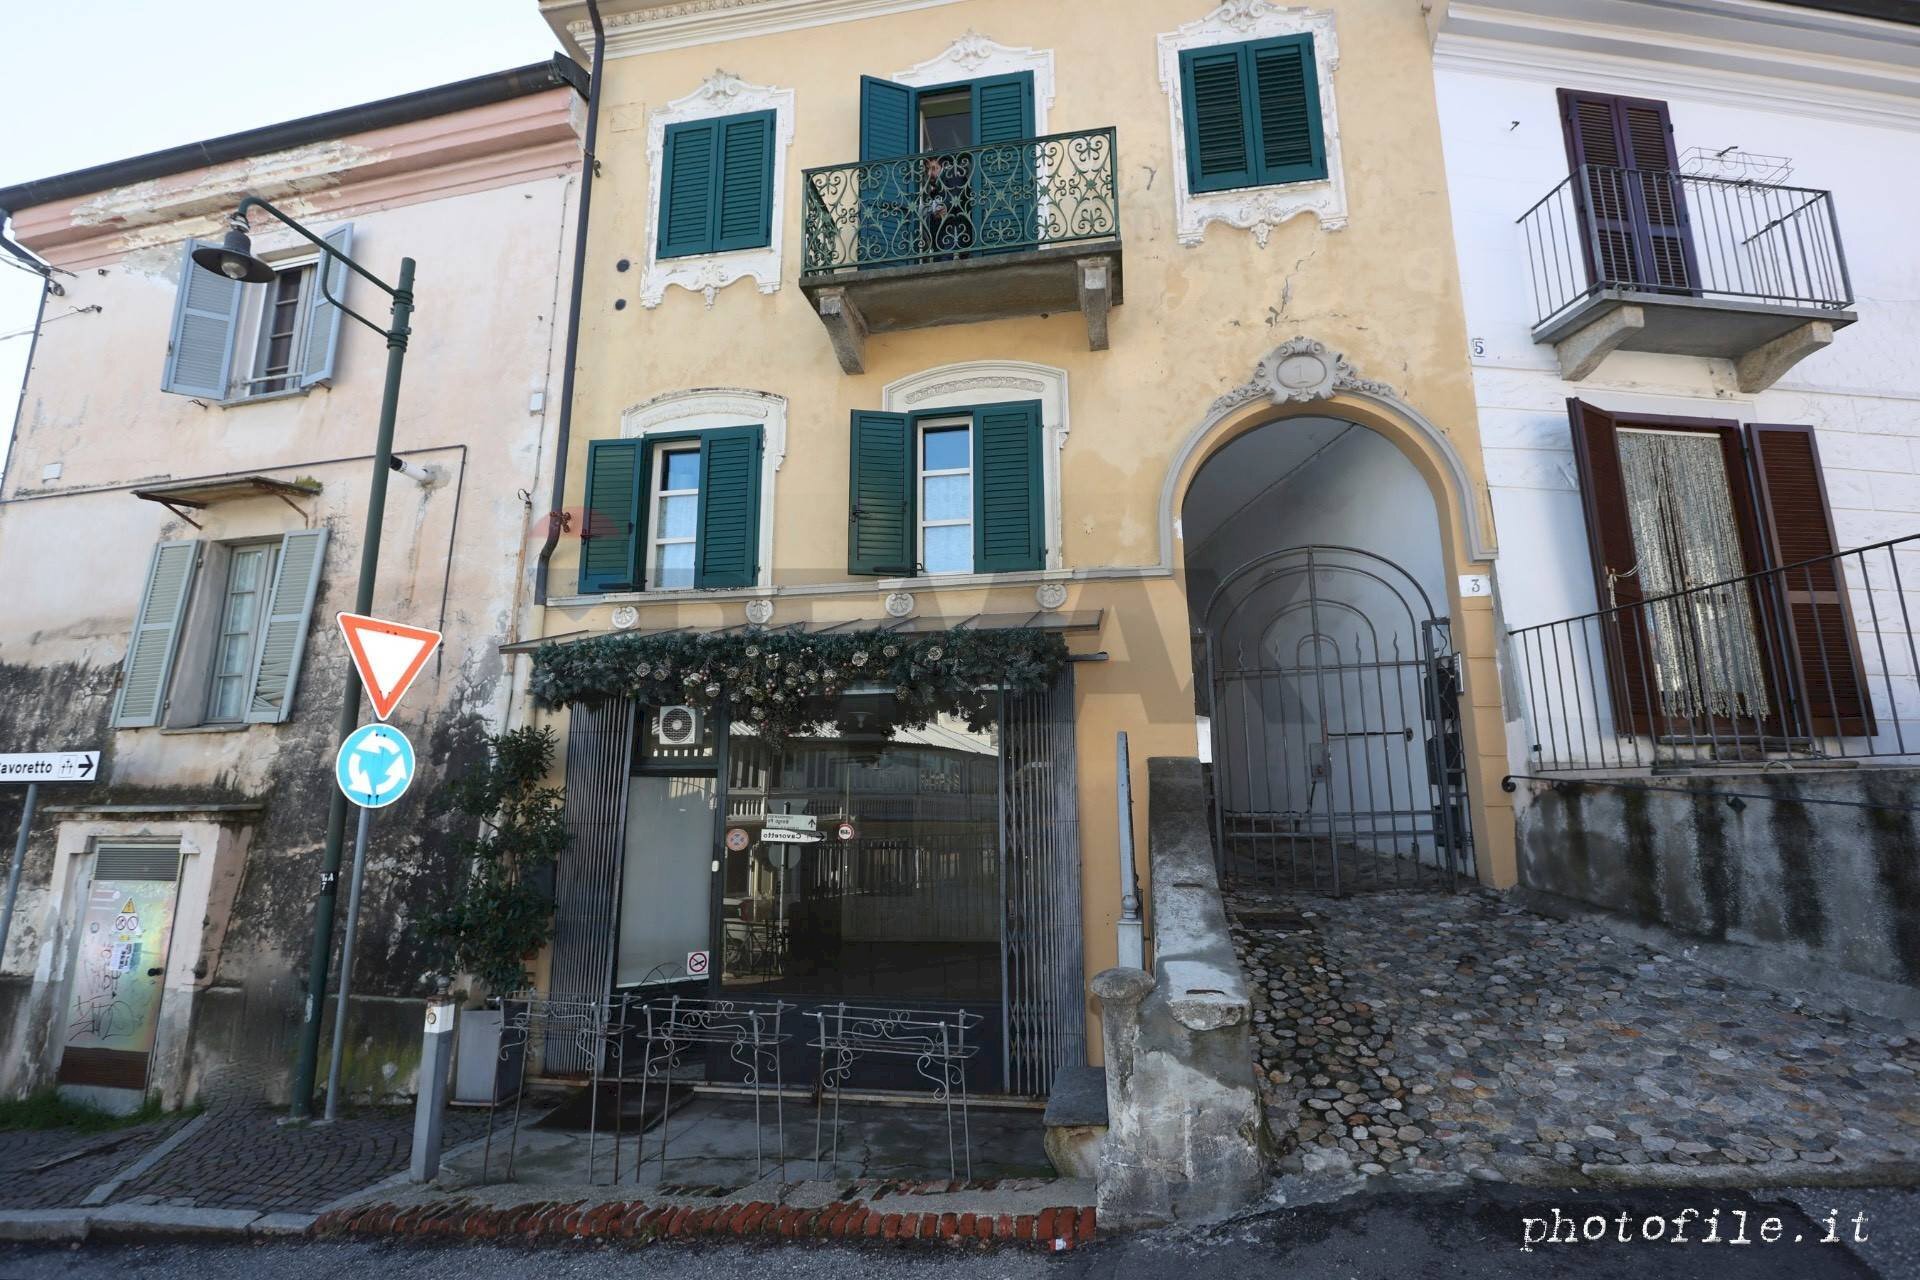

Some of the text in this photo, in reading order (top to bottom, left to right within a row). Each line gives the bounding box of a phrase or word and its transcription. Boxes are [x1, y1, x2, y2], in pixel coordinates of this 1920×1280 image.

[1475, 340, 1484, 355] 5
[1471, 578, 1481, 593] 3
[0, 760, 53, 774] avoretto
